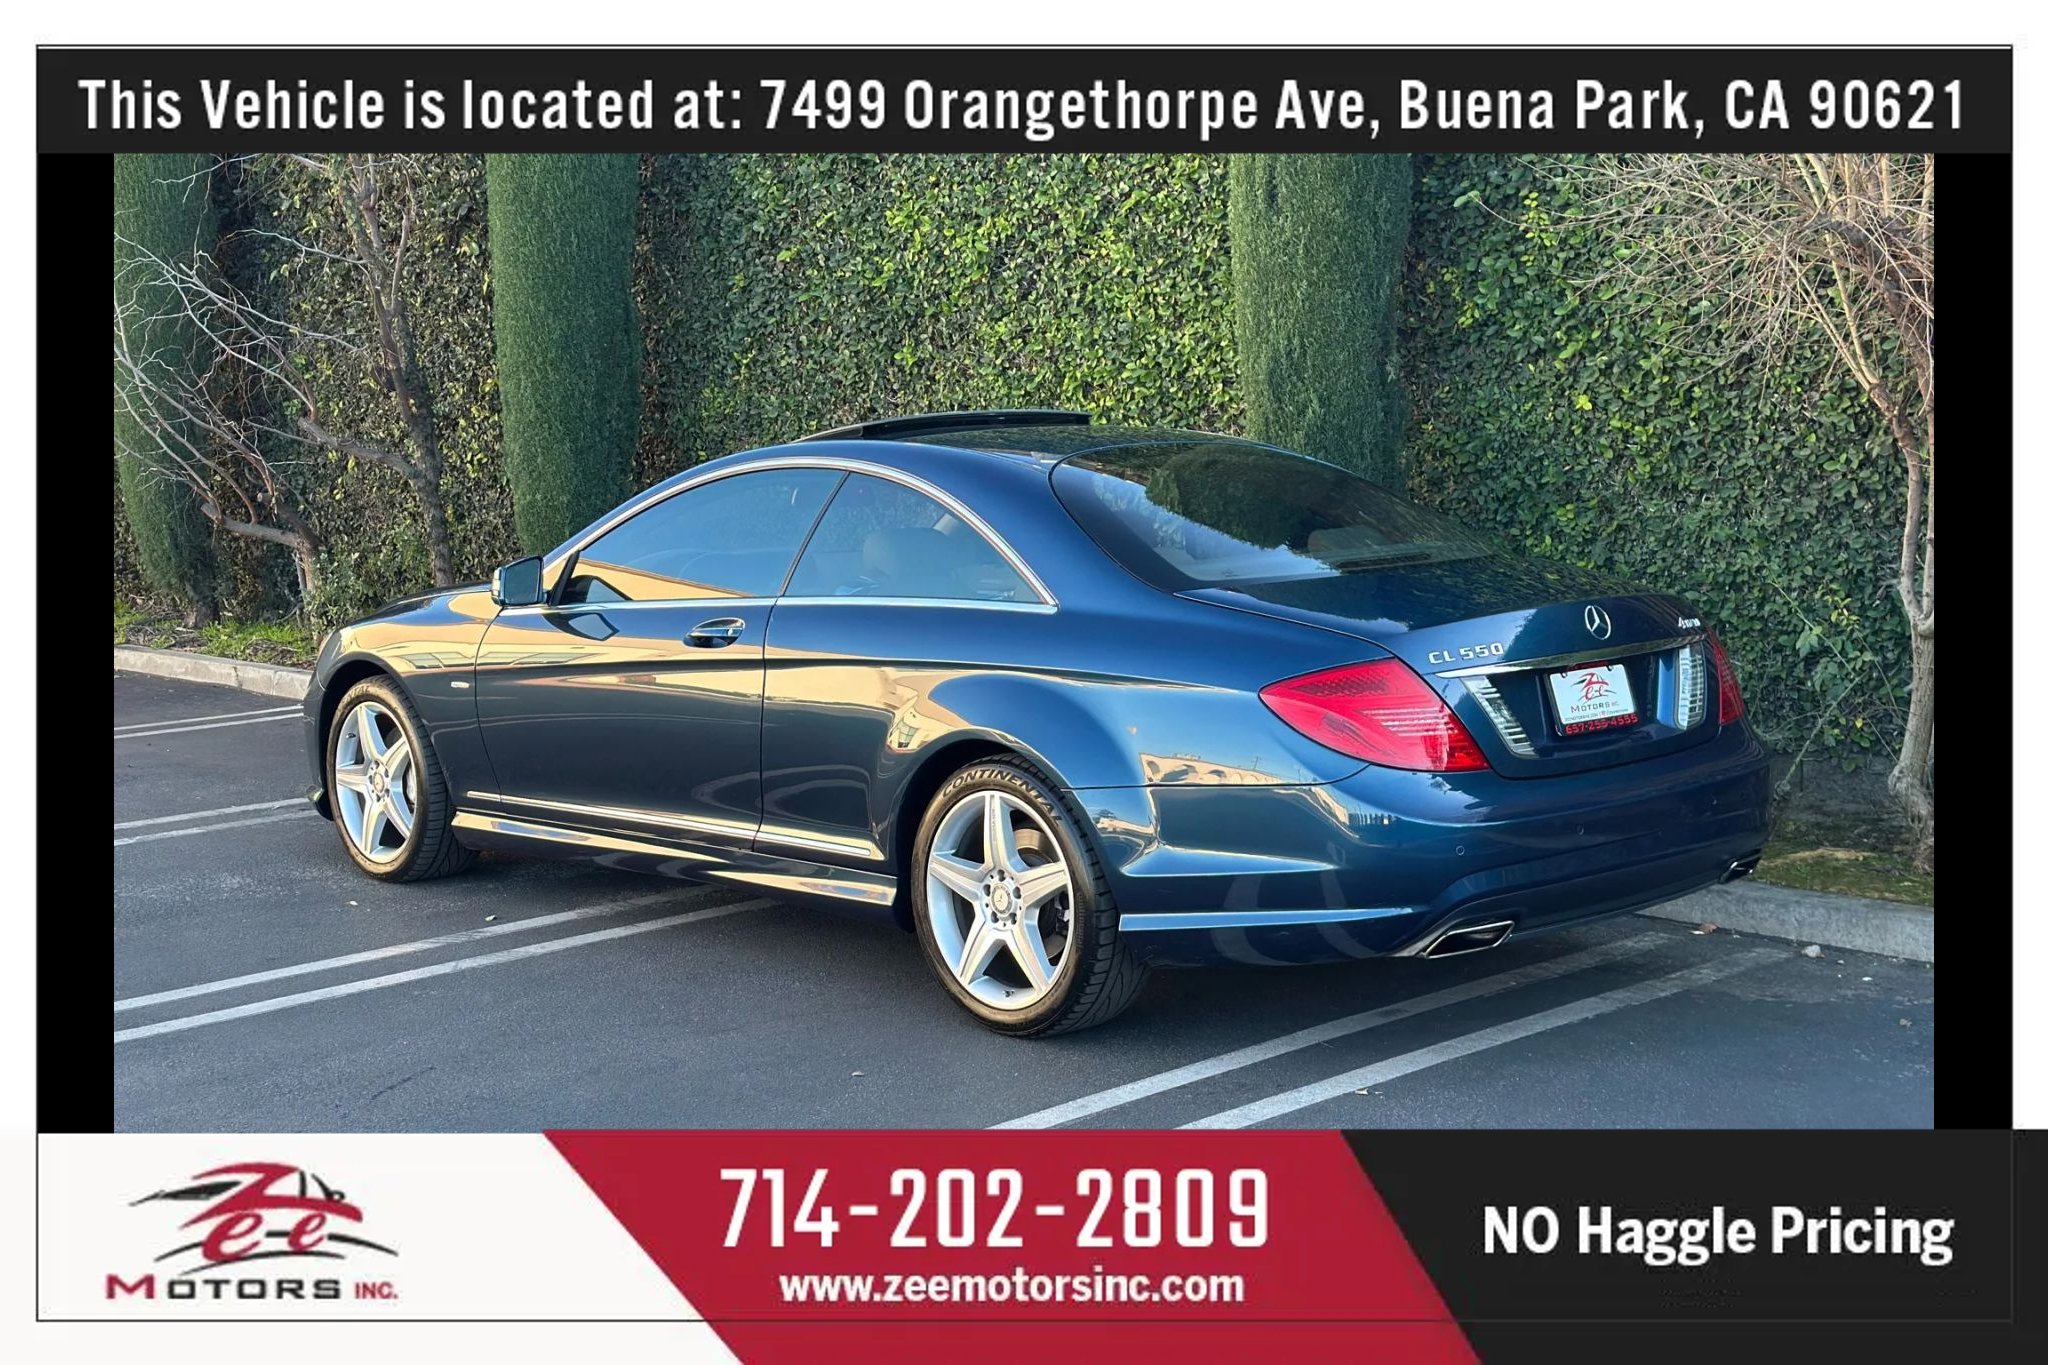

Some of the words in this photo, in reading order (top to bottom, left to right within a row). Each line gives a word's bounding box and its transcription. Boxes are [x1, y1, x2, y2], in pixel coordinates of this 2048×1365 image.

[1428, 650, 1456, 664] CL
[1459, 642, 1504, 660] 550
[943, 769, 1063, 827] CONTINENTAL
